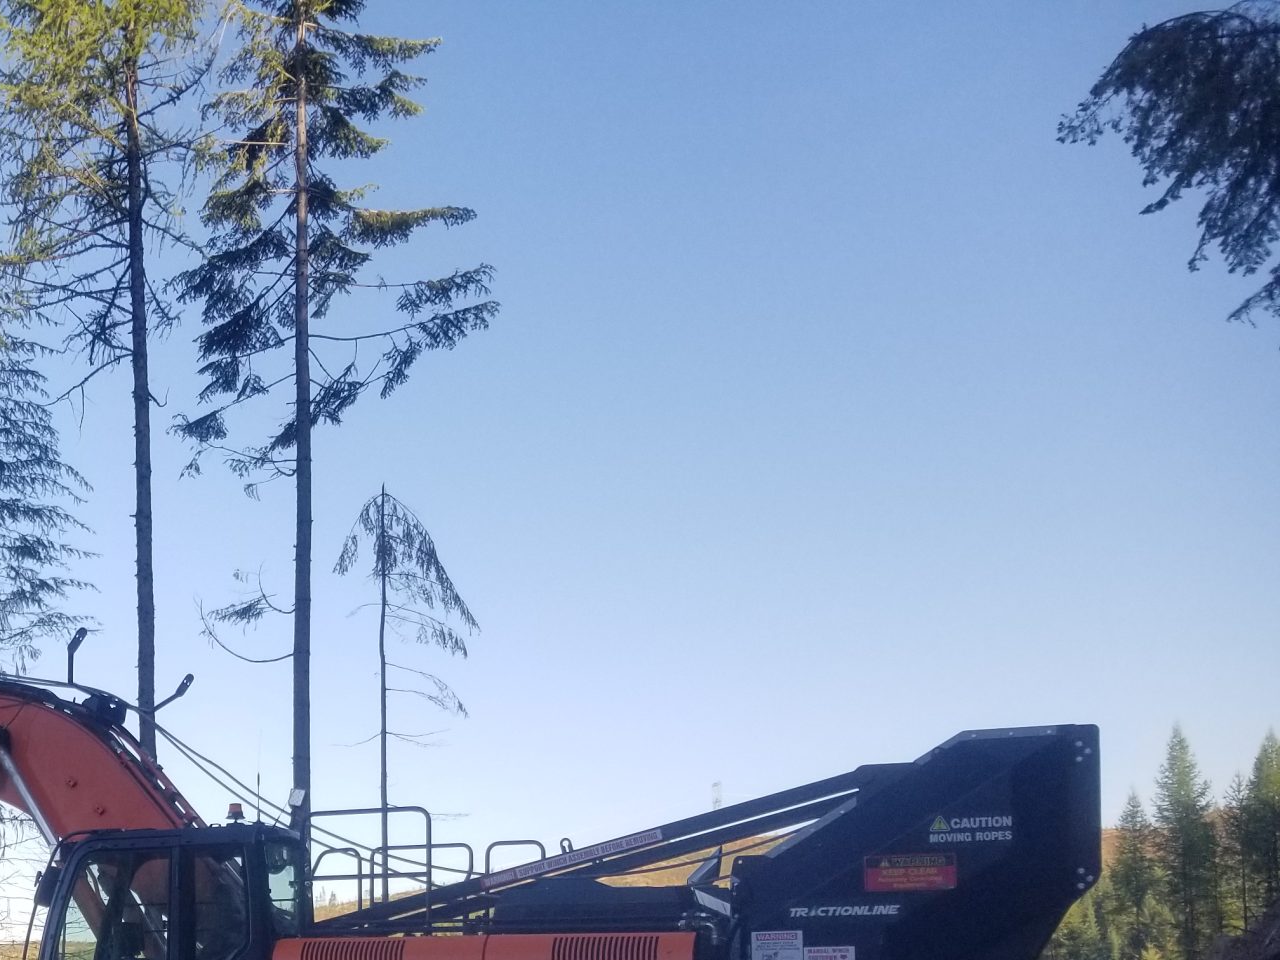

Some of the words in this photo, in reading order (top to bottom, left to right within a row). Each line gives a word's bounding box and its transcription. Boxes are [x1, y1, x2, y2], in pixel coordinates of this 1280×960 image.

[950, 816, 1012, 829] CAUTION
[929, 832, 972, 843] MOVING
[975, 831, 1013, 841] ROPES
[601, 840, 624, 854] BEFORE
[789, 905, 900, 917] TRACTIONLINE
[757, 933, 797, 941] WARNING
